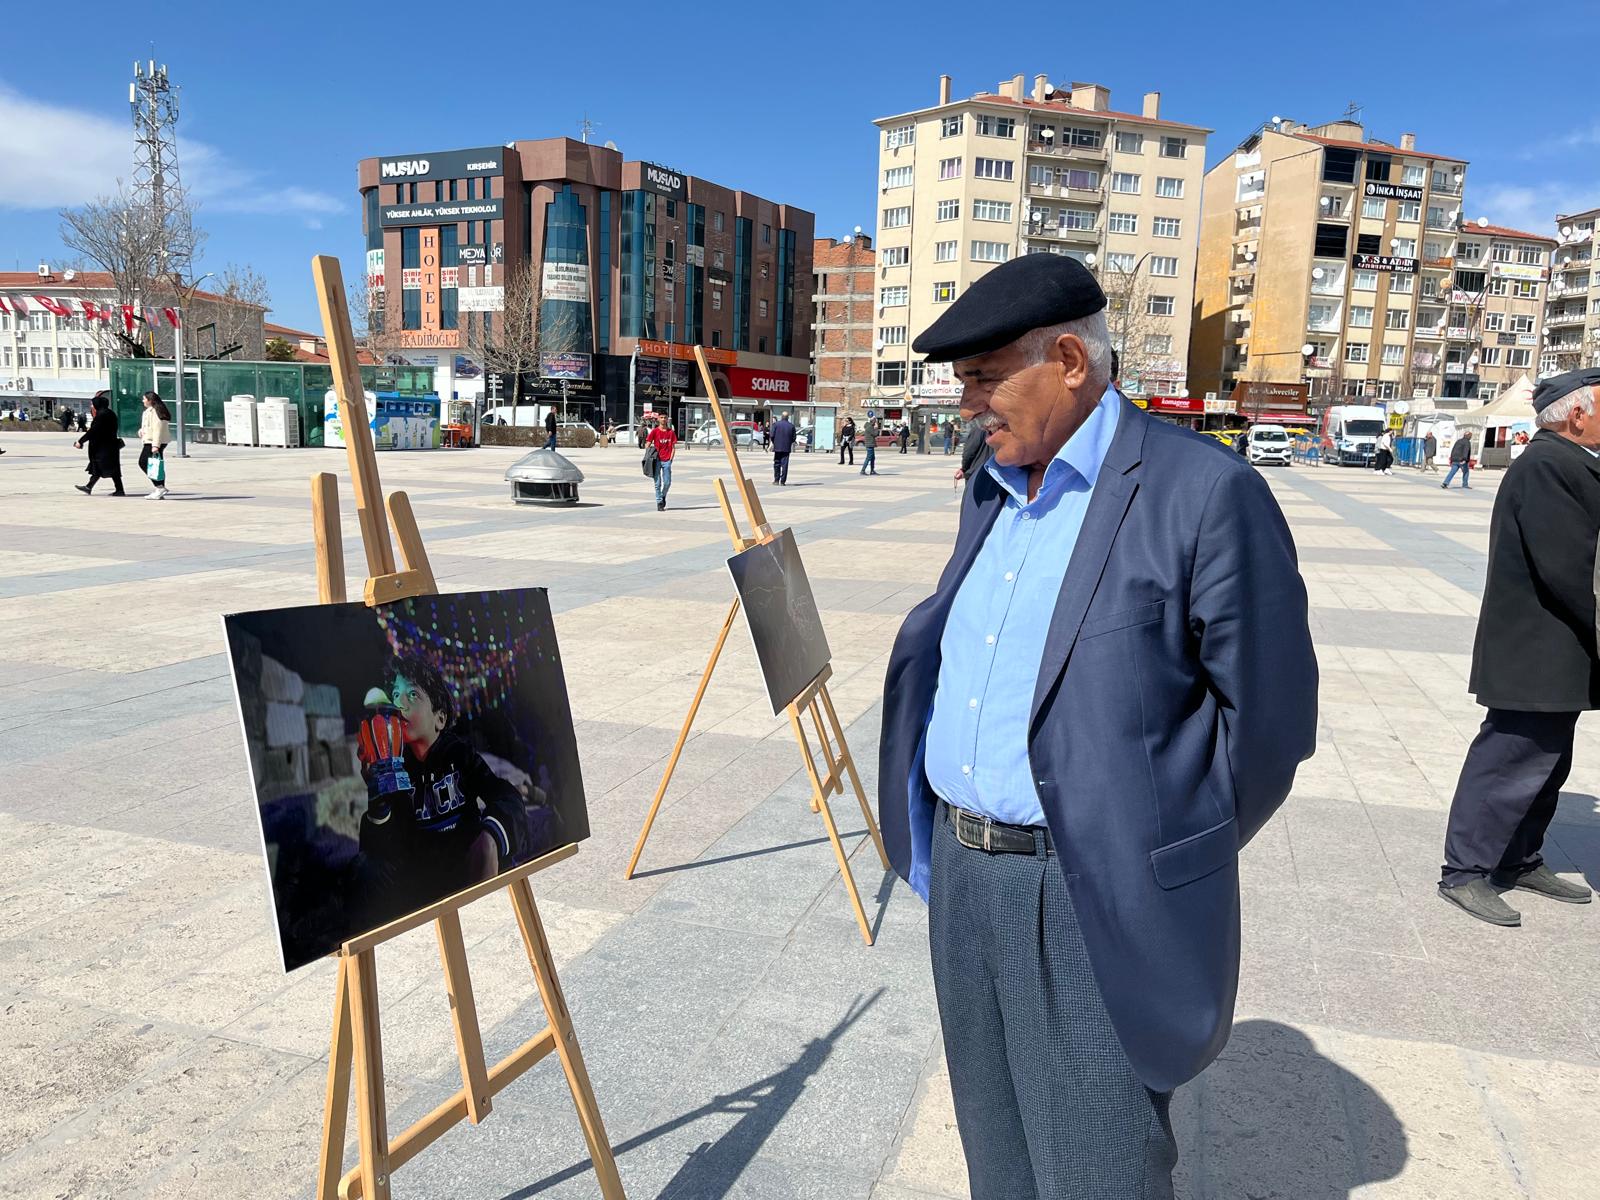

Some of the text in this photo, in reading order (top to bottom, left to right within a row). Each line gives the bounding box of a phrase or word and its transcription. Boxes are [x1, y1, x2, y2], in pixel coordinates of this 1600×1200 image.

[1375, 184, 1423, 199] İNKA İNŞAAT
[386, 209, 410, 219] YÜKSEK
[434, 206, 461, 216] YÜKSEK
[461, 204, 497, 214] TEKNOLOJİ
[423, 236, 435, 324] HOTEL
[645, 343, 681, 356] HOTEL
[751, 377, 790, 393] SCHAFER
[1161, 397, 1190, 407] komagene
